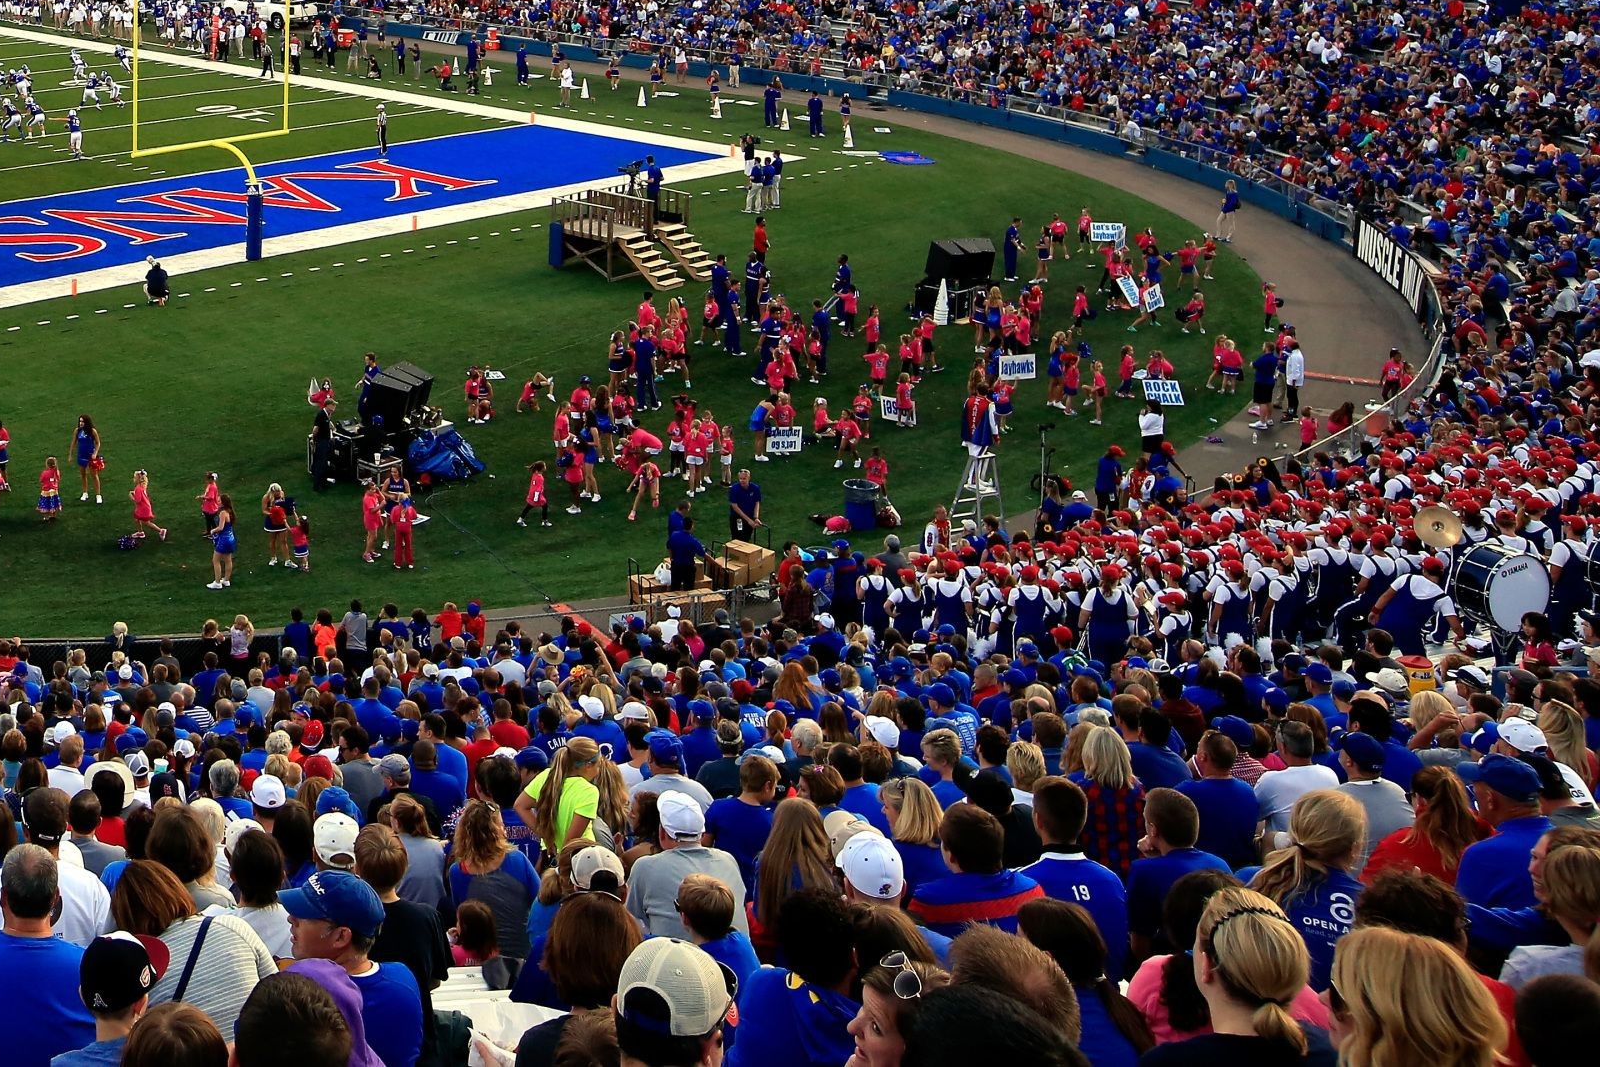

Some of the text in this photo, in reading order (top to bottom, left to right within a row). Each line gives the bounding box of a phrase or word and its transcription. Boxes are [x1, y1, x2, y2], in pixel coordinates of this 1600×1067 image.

[195, 104, 276, 119] 10
[1092, 231, 1117, 240] Jayhaw
[1357, 219, 1403, 290] MUSCLE
[1148, 288, 1158, 299] 1st
[1000, 359, 1035, 375] Jayhawks
[1145, 380, 1179, 392] ROCK
[1146, 391, 1183, 404] CHALK
[771, 440, 780, 449] Go
[1507, 562, 1529, 576] YAMAHA
[548, 736, 567, 750] CAIN
[1071, 884, 1091, 901] 19
[1302, 916, 1339, 932] OPEN
